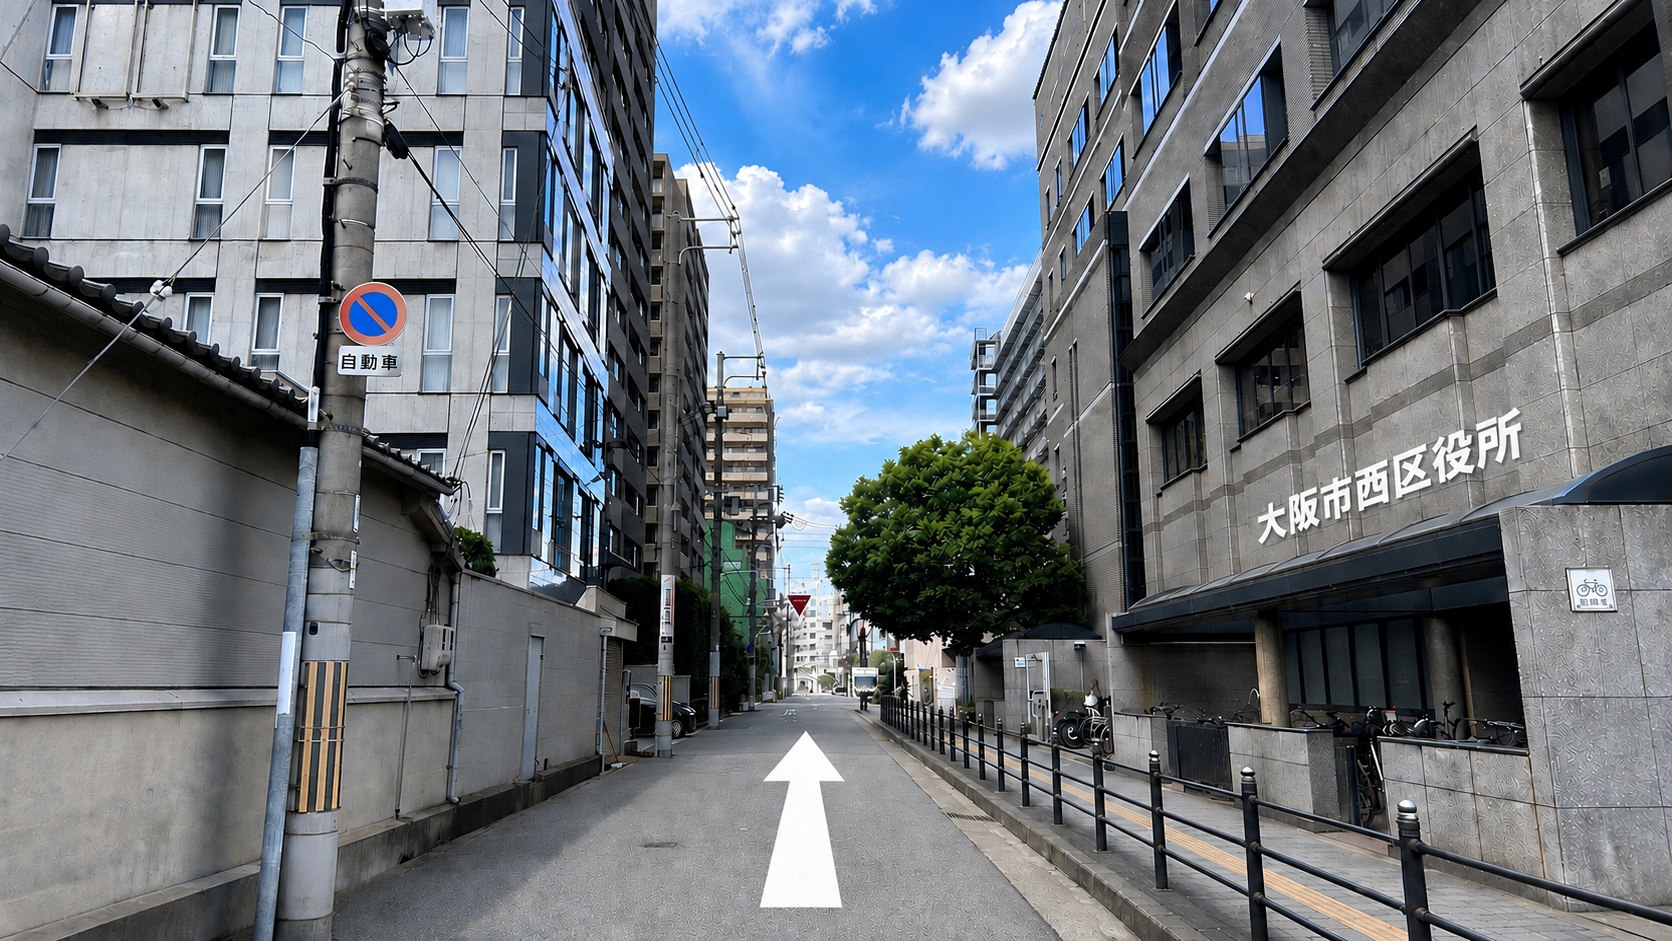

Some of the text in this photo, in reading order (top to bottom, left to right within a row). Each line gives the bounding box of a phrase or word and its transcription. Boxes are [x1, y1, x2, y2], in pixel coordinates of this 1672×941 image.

[341, 353, 398, 371] 自動車
[1257, 407, 1522, 545] 大阪市西区役所
